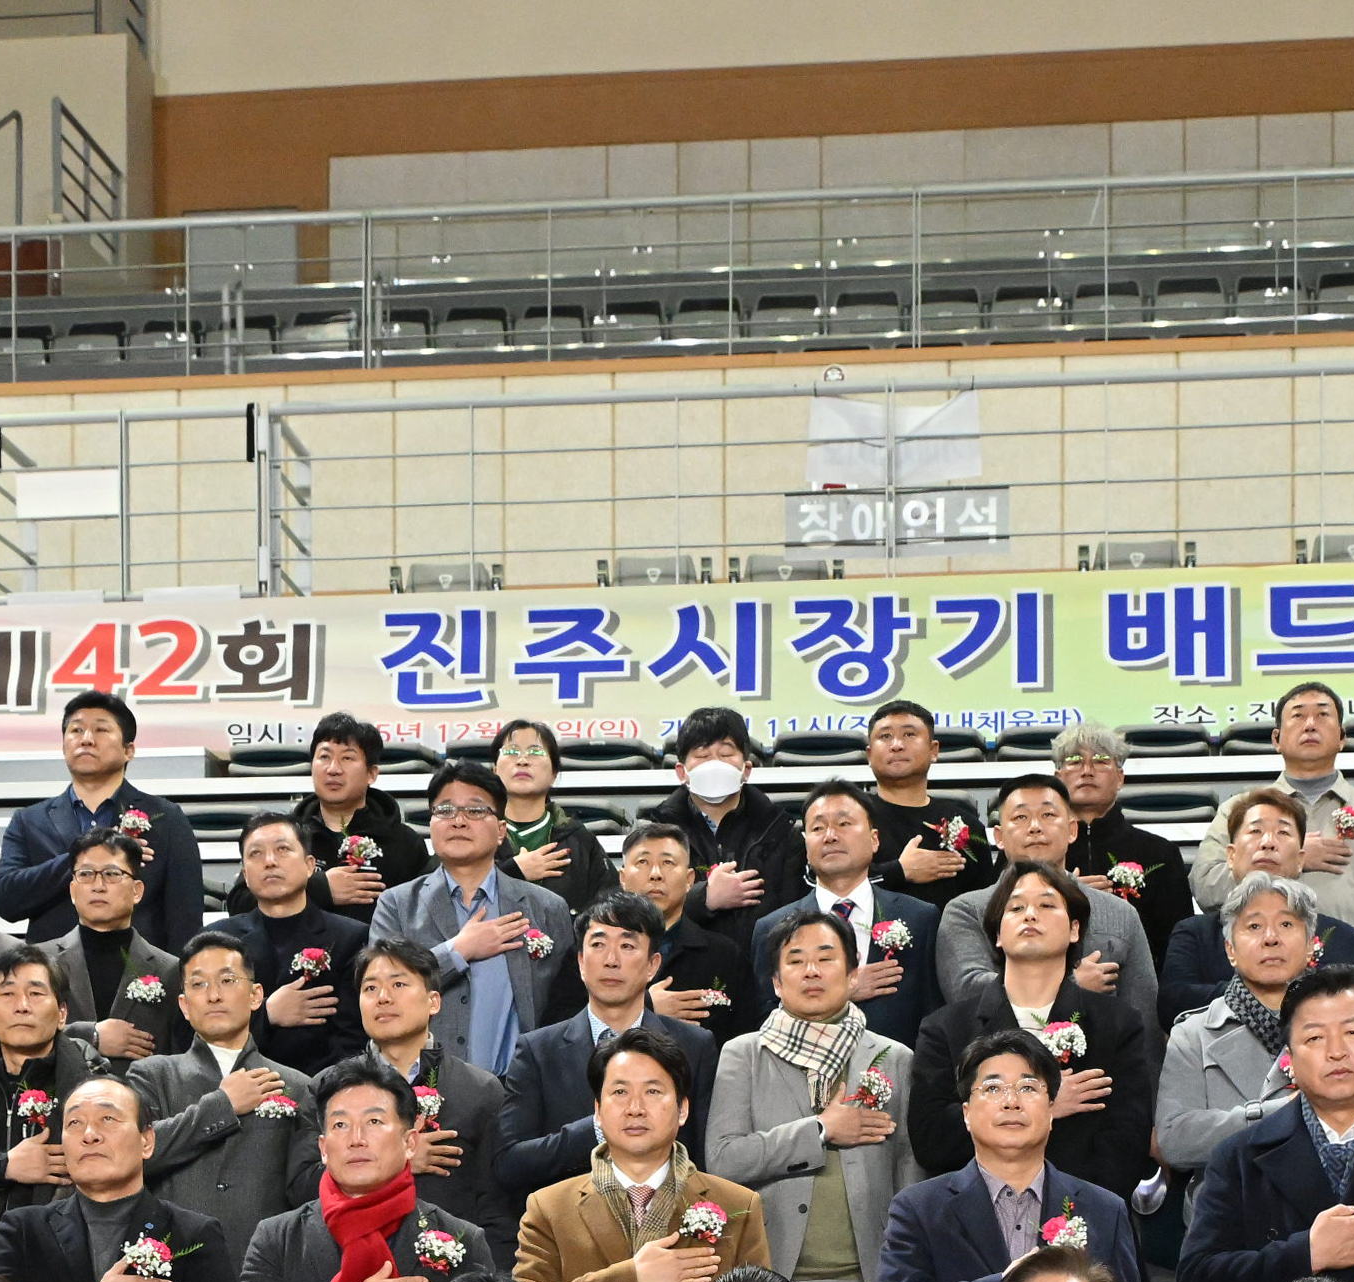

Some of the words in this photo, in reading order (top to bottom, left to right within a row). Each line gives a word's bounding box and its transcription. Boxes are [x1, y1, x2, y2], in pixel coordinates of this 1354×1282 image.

[798, 496, 999, 546] 장애인석
[381, 590, 1045, 704] 진주시장기
[1153, 704, 1217, 725] 장소
[227, 723, 283, 746] 일시
